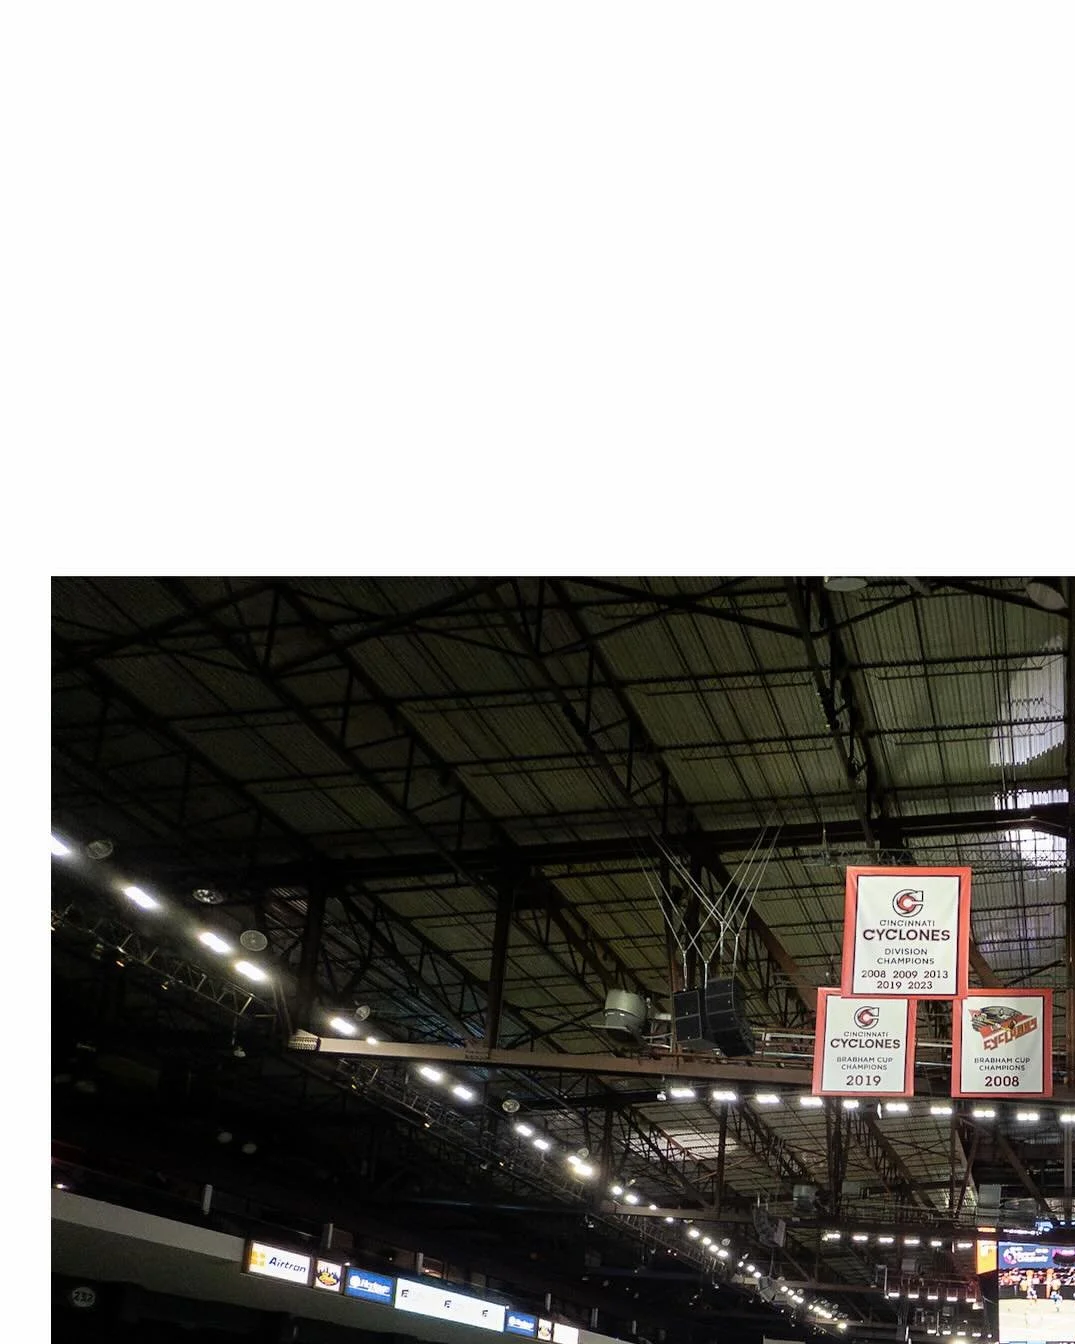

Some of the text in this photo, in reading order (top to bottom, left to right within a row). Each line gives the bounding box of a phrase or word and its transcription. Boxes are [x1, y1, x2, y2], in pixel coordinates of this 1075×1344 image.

[879, 919, 935, 927] CINCINNATI
[862, 929, 951, 941] CYCLONES
[884, 948, 928, 956] DIVISION
[876, 957, 935, 965] CHAMPIONS
[861, 969, 949, 979] 2008 2009 2013
[877, 981, 933, 990] 2019 2023
[830, 1038, 901, 1049] CYCLONES
[846, 1075, 882, 1086] 2019
[984, 1075, 1020, 1087] 2008
